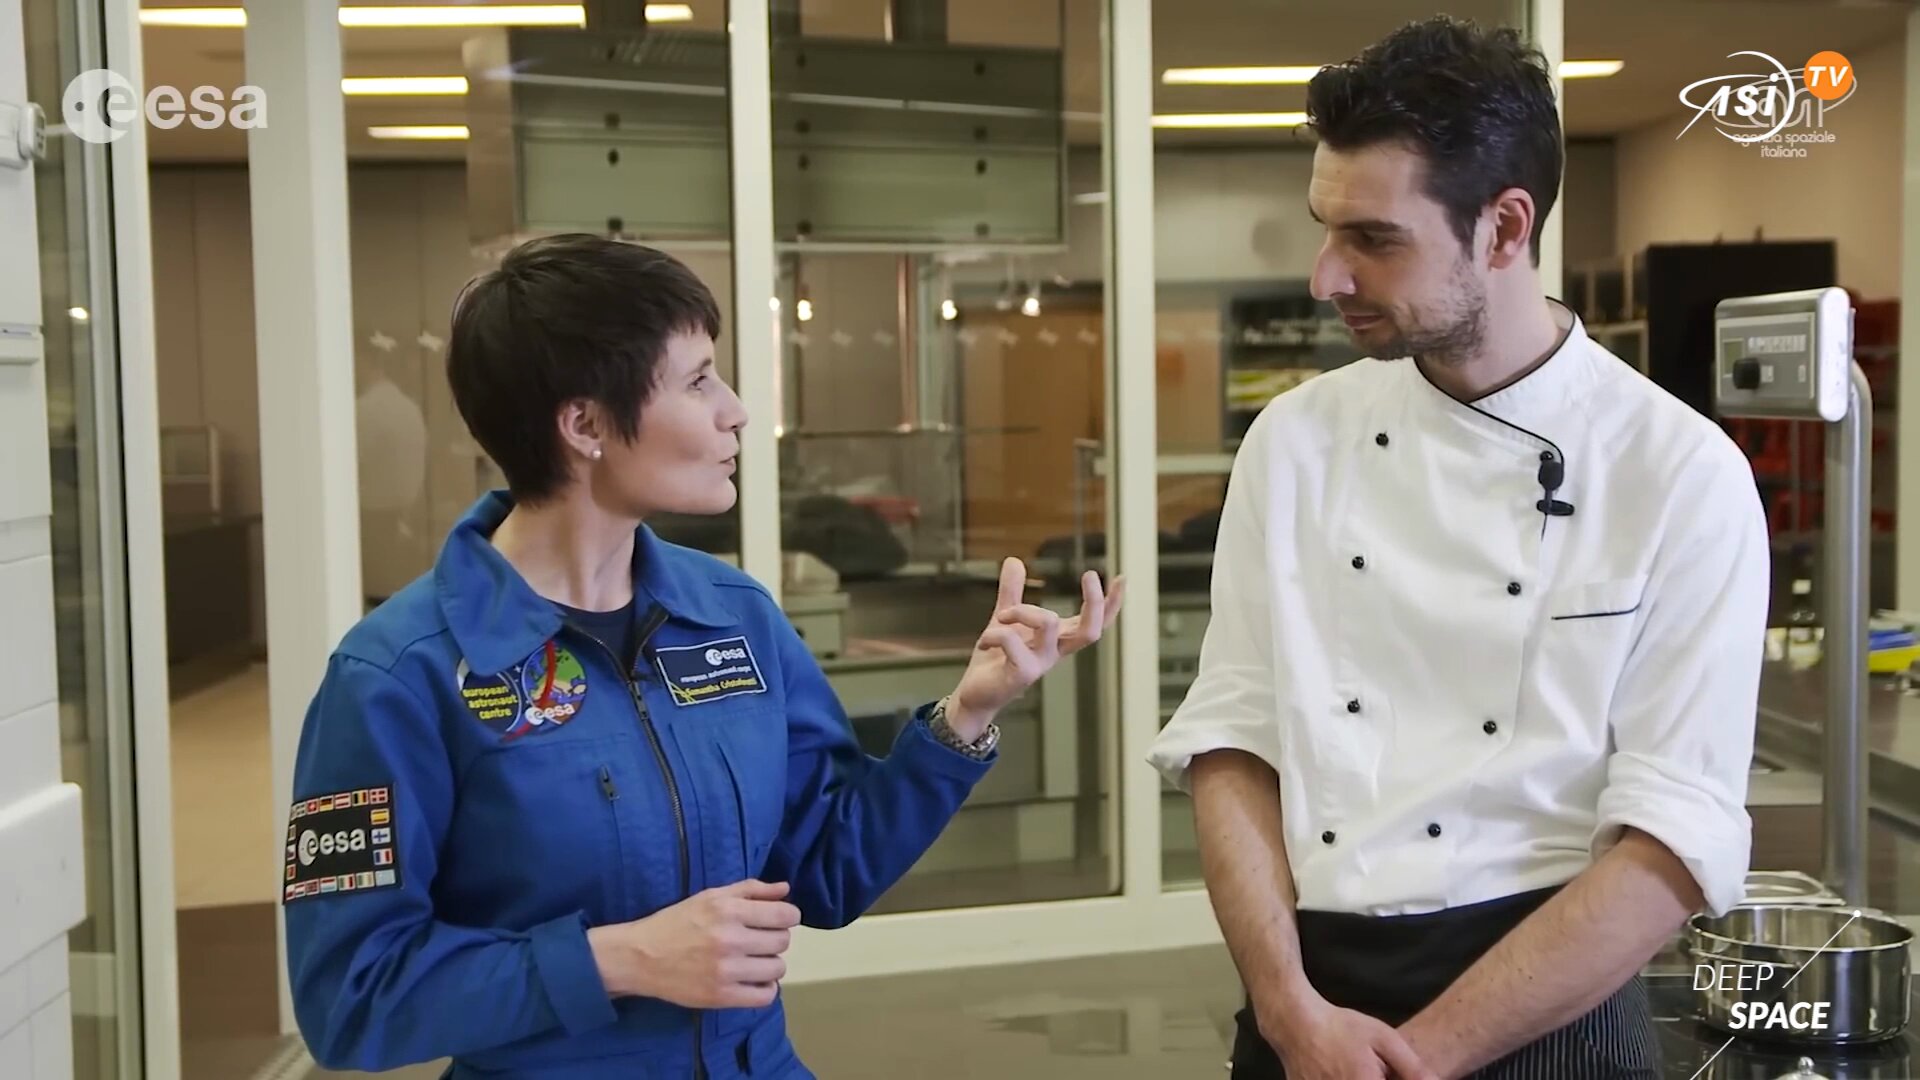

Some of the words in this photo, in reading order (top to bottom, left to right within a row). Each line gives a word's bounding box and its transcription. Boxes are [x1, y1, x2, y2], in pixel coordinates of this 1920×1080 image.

[462, 686, 509, 697] european
[468, 694, 518, 709] astronaut
[479, 707, 512, 720] centre
